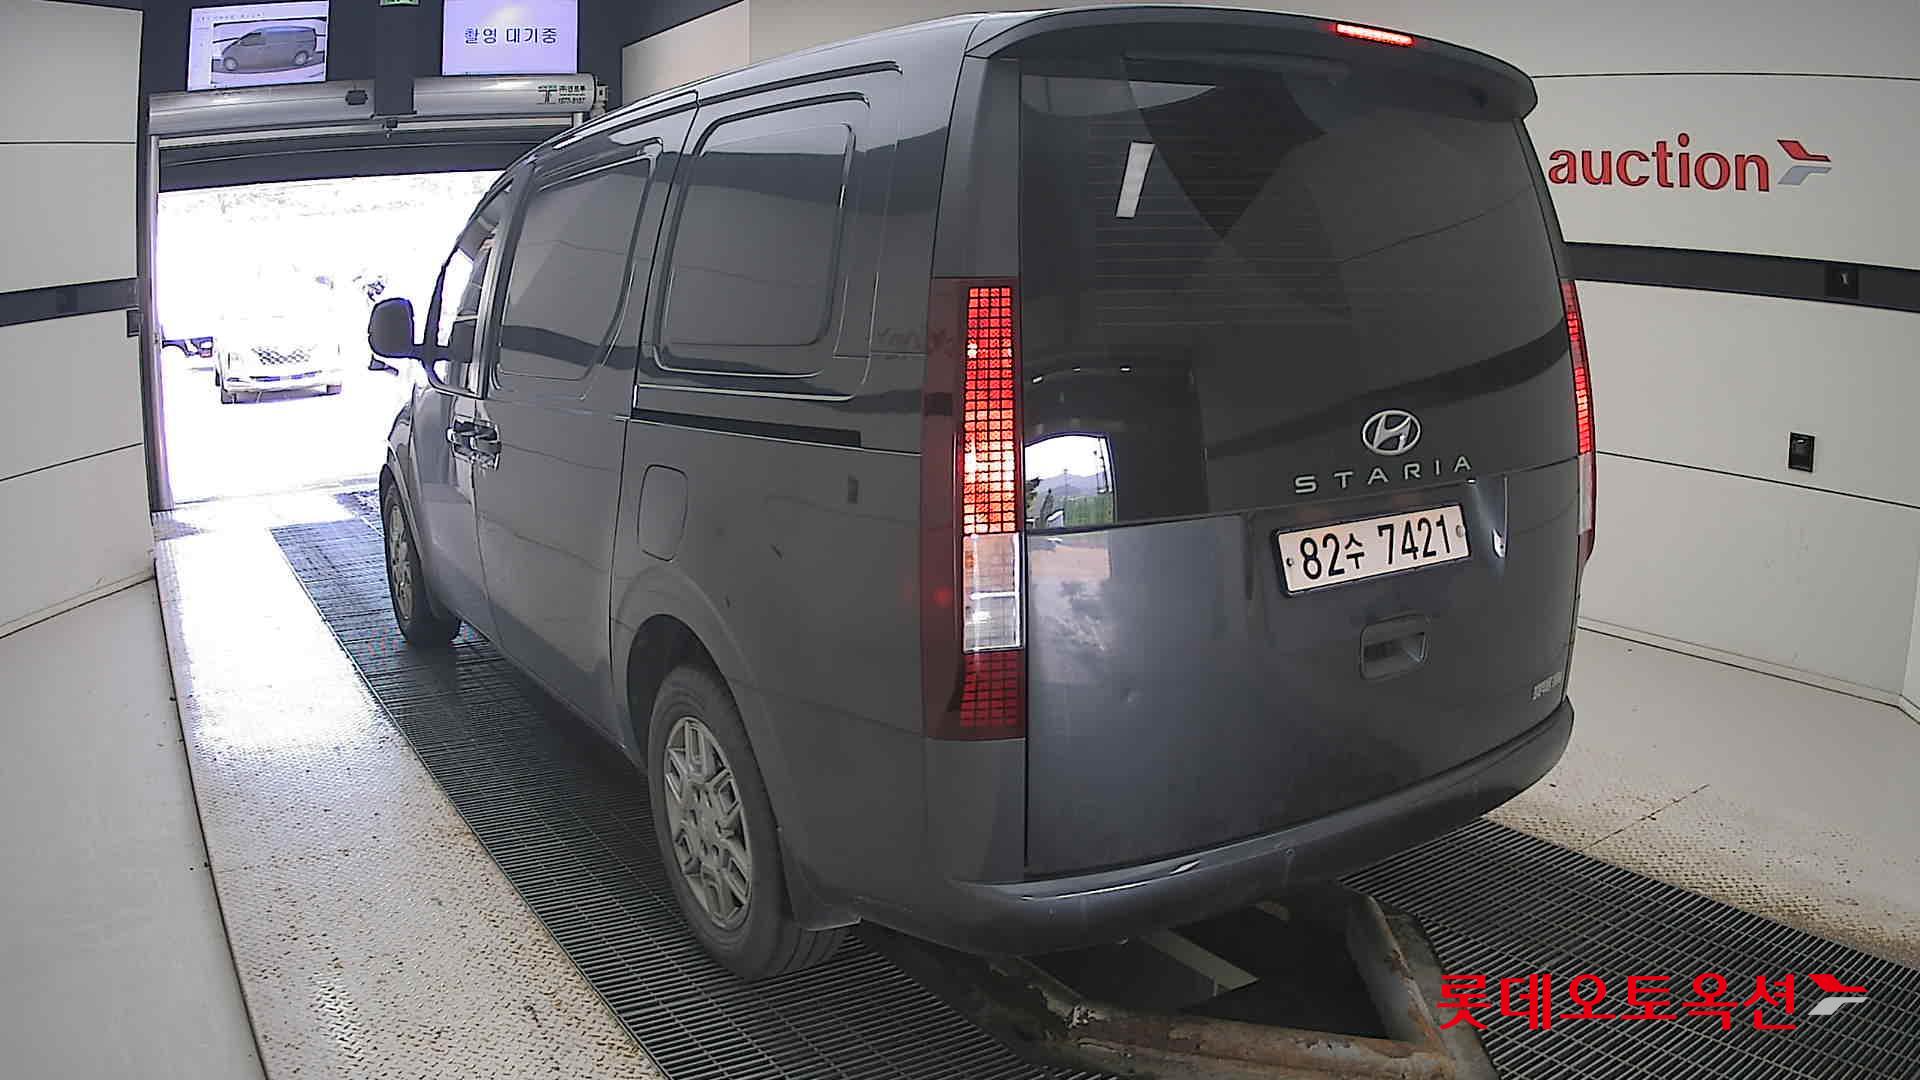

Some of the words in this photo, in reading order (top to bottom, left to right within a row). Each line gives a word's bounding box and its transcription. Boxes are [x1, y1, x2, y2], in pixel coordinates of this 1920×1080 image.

[506, 28, 557, 44] 대기중
[1549, 132, 1770, 192] auction
[1294, 456, 1472, 494] STARIA
[1300, 533, 1365, 580] 82수
[1377, 514, 1451, 566] 7421
